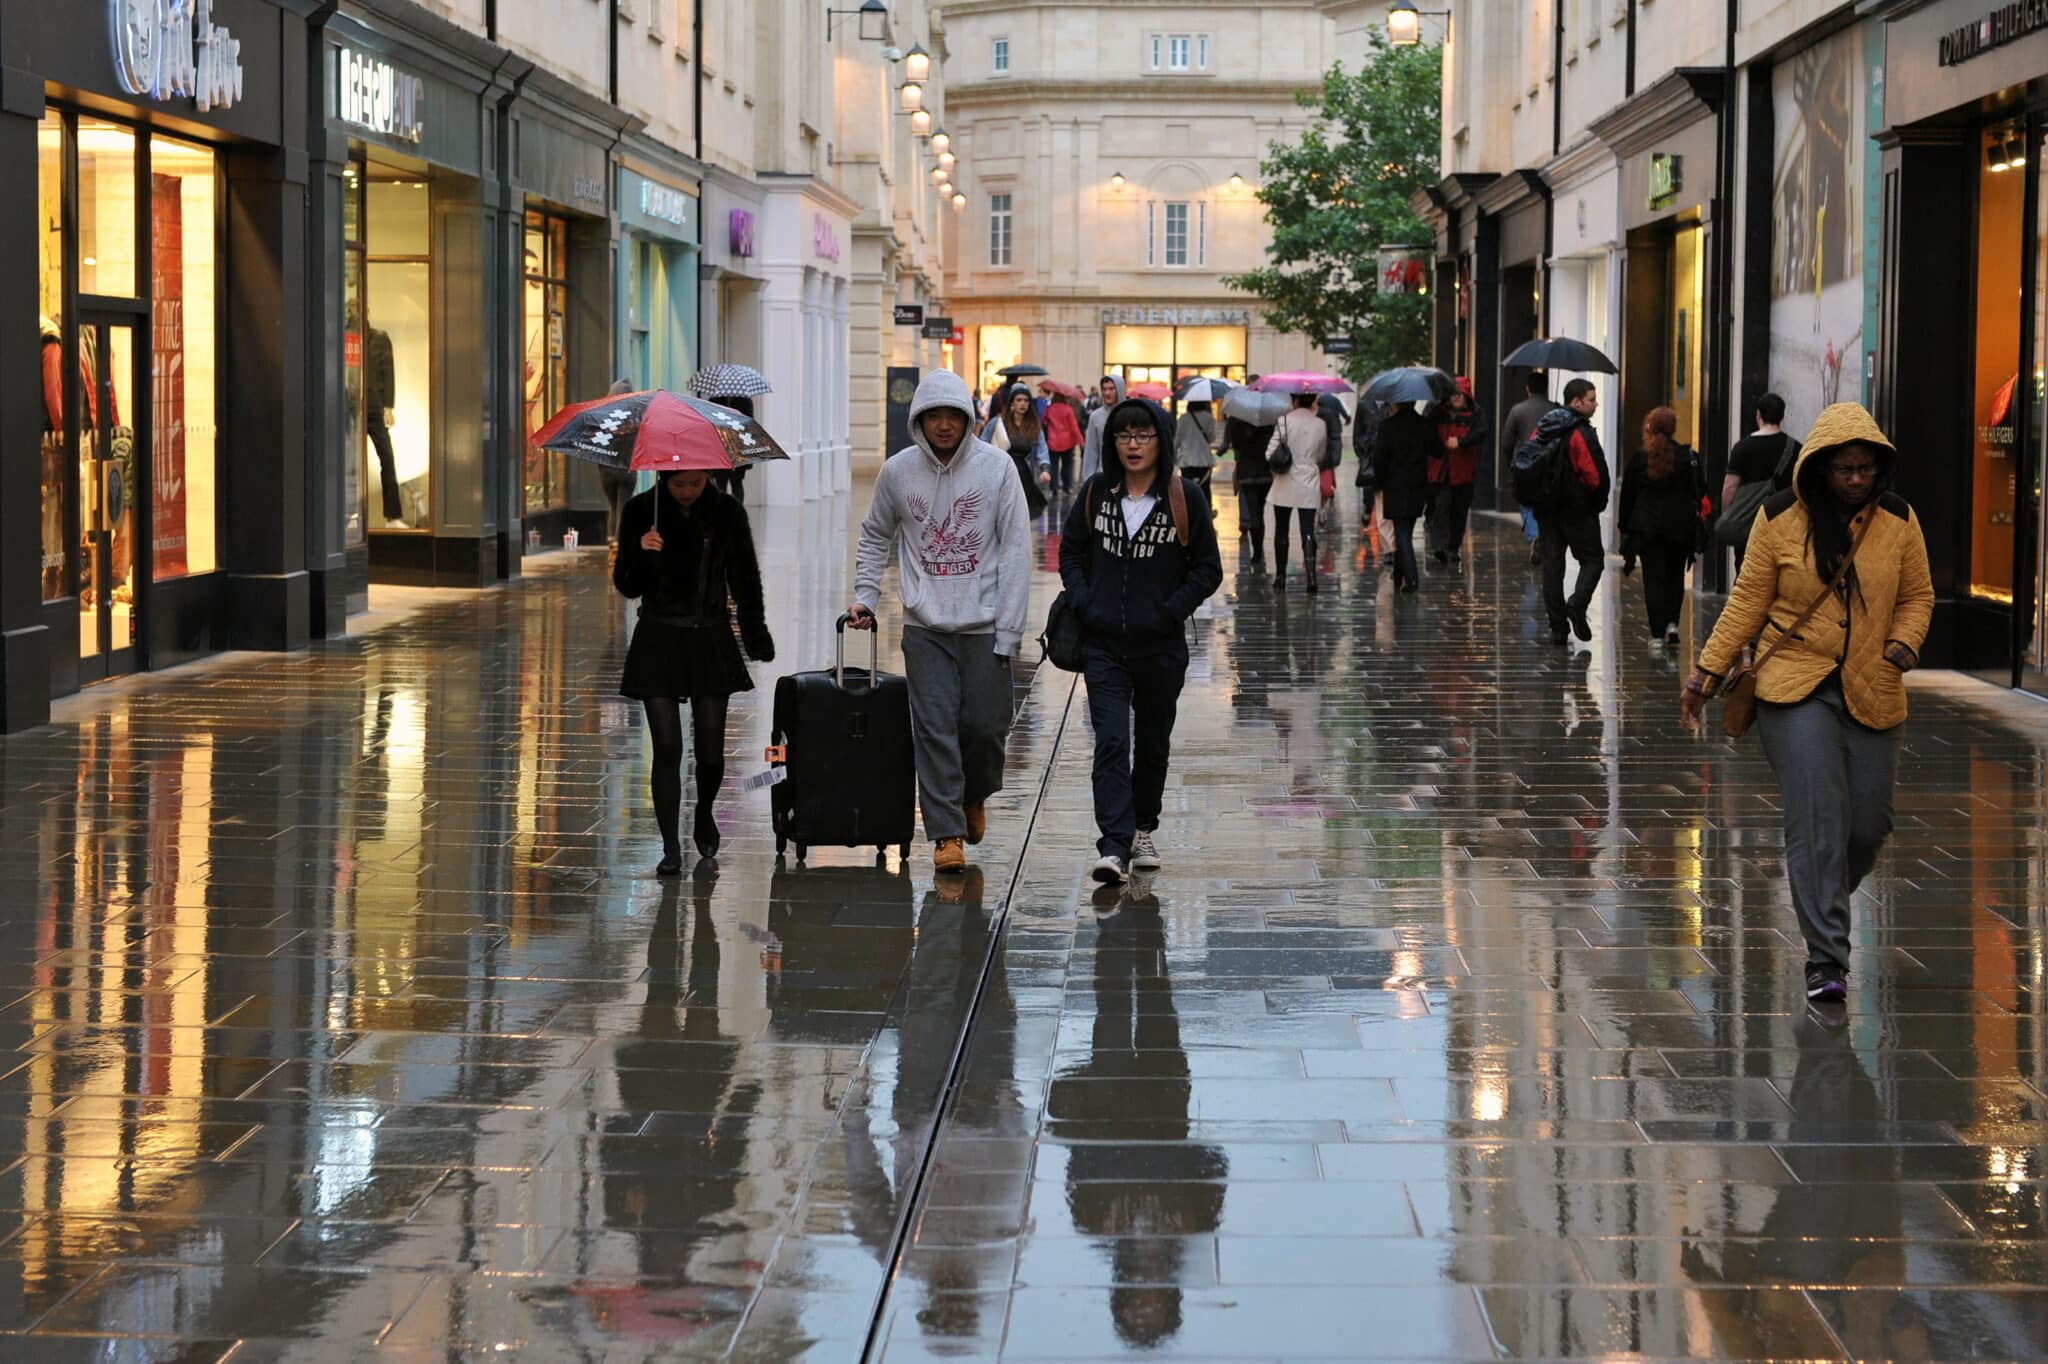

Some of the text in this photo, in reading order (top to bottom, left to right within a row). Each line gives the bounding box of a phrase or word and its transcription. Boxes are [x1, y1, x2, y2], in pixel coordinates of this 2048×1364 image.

[1939, 18, 1982, 67] TOMMY
[1102, 308, 1250, 326] DEBENHAMS
[926, 561, 973, 575] HILFIGER
